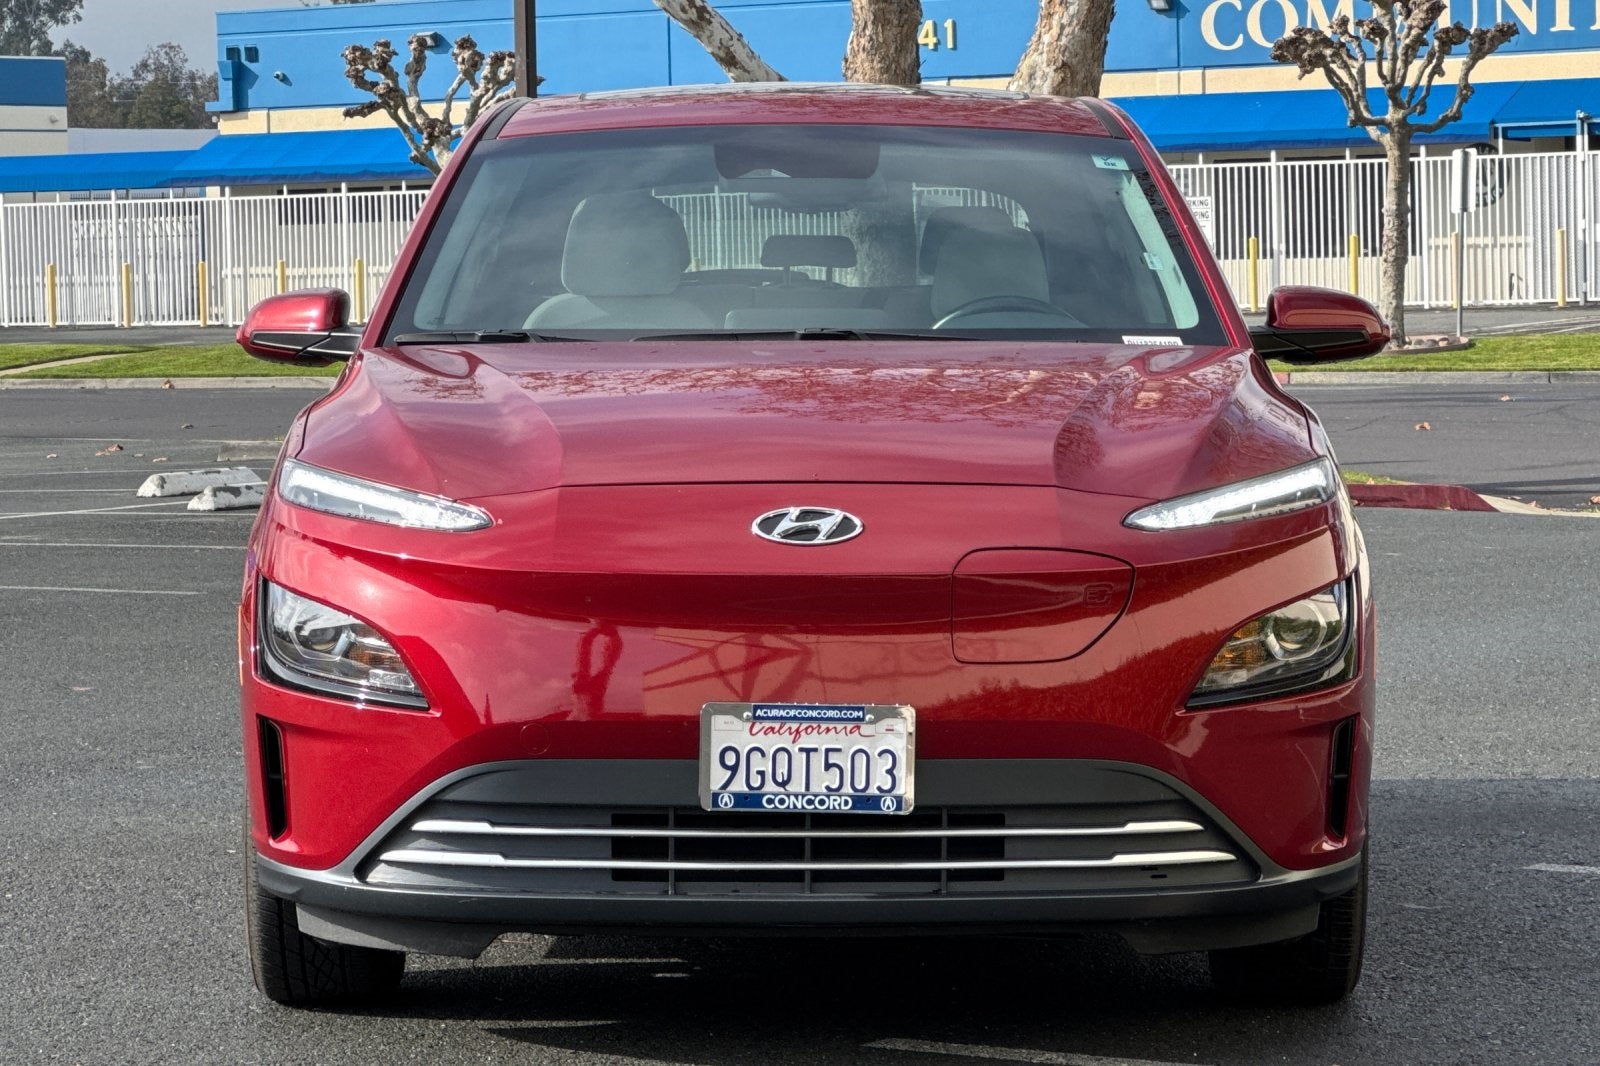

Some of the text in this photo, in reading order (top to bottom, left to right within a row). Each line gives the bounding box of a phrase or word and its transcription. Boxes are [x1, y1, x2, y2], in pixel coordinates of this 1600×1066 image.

[755, 708, 863, 719] ACURAOFCONCORD.COM
[749, 721, 876, 744] California
[718, 746, 897, 793] 9GQT503
[762, 795, 852, 810] CONCORD
